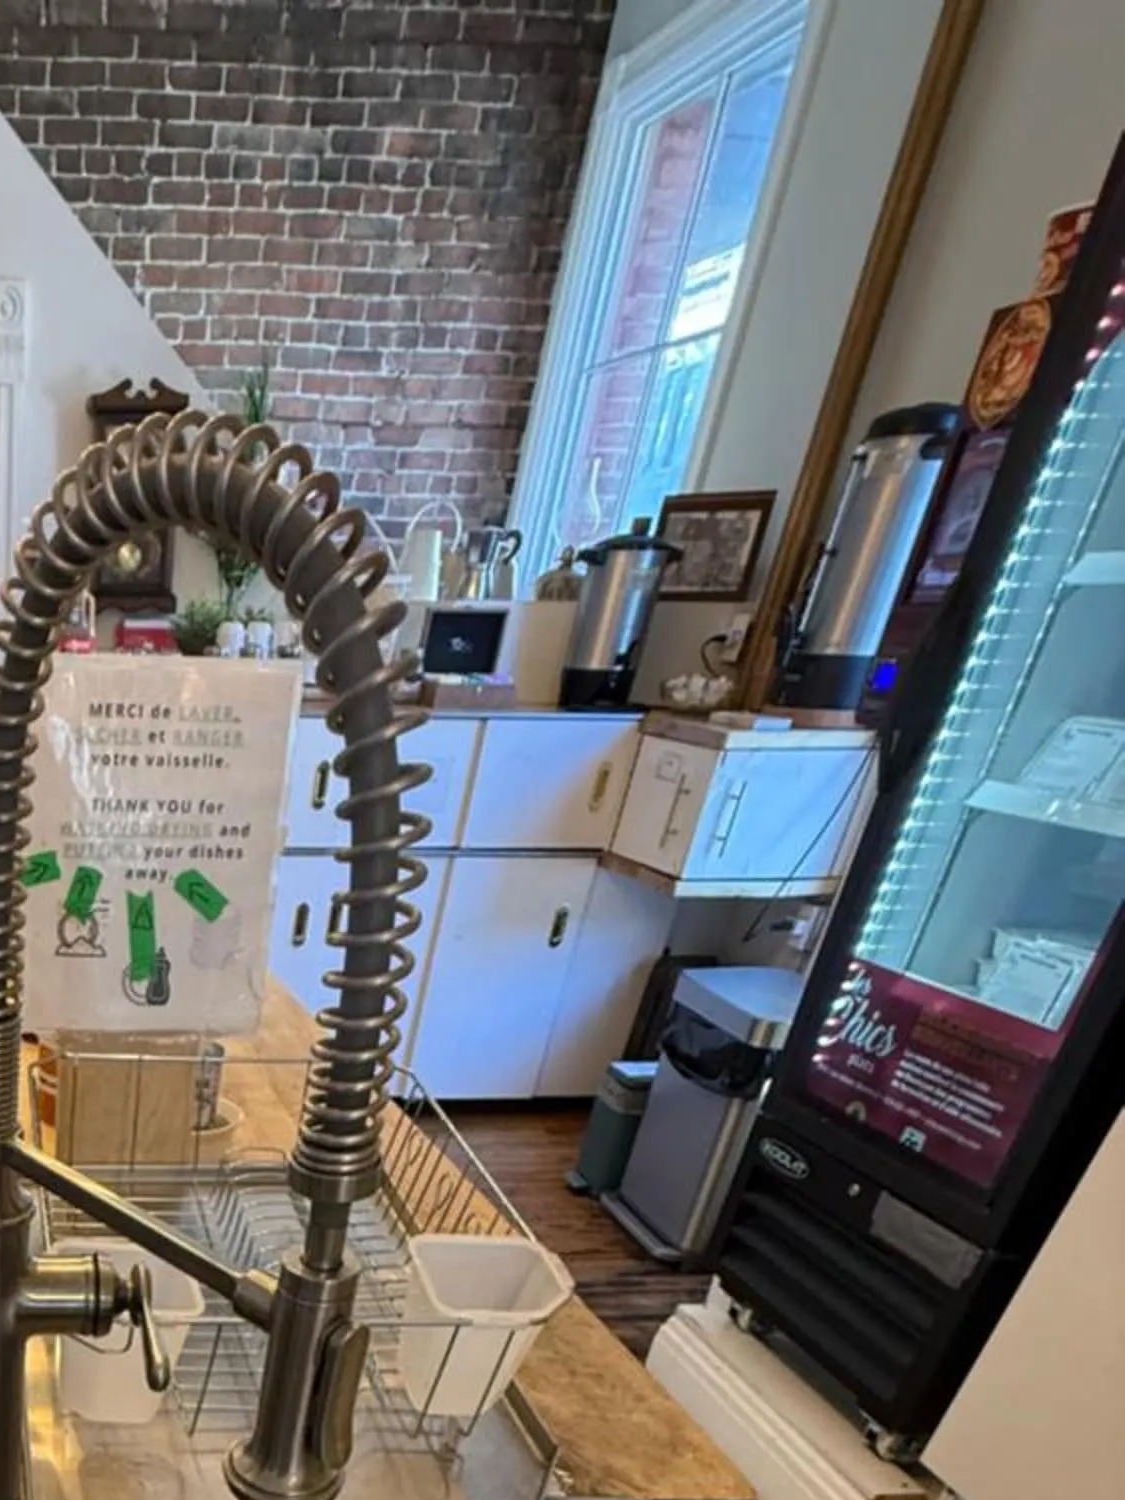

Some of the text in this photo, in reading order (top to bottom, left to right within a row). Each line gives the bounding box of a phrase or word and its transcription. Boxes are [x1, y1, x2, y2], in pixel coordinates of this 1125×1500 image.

[88, 703, 144, 719] MERCI
[150, 704, 171, 719] de
[147, 731, 166, 744] et
[90, 753, 230, 768] votre vaisselle.
[92, 799, 225, 814] THANK YOU for
[219, 824, 251, 838] and
[143, 846, 183, 861] your
[189, 844, 244, 859] dishes
[124, 868, 174, 883] away.
